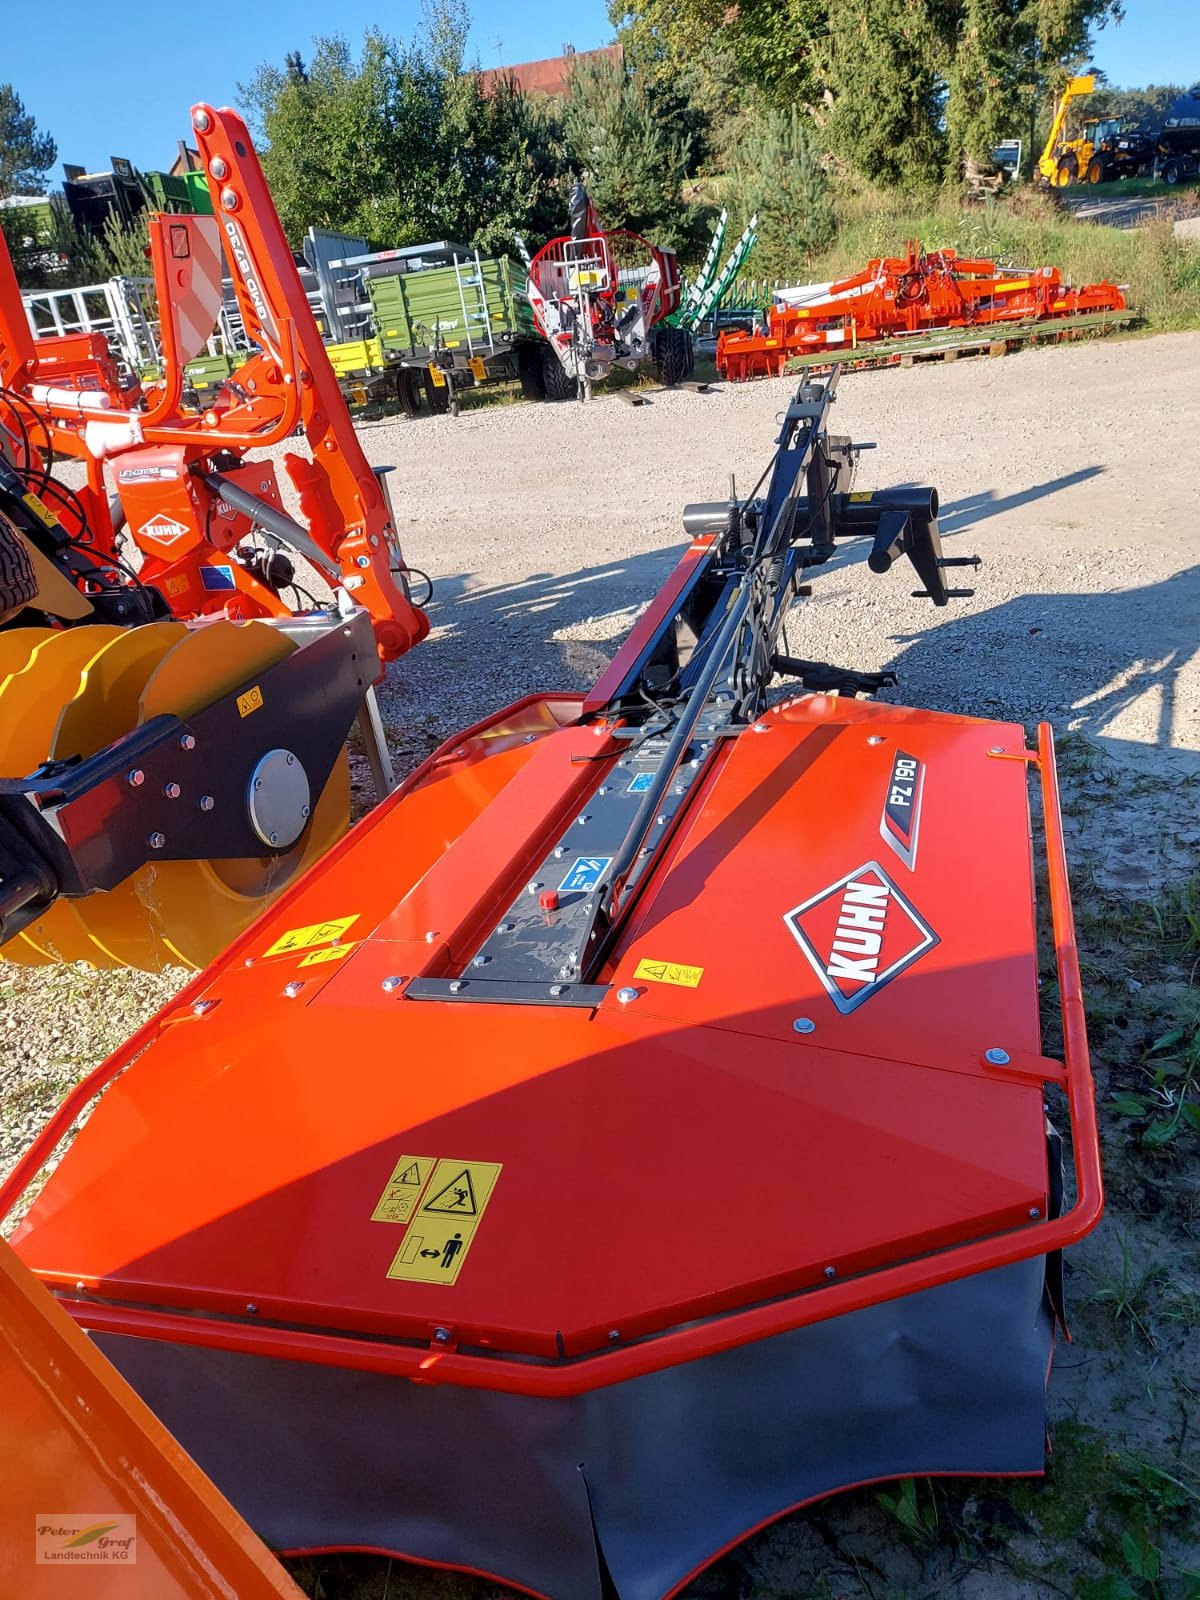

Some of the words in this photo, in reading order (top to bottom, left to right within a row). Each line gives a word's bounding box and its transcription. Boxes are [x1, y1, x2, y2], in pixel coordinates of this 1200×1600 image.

[226, 222, 250, 273] 8730
[247, 278, 267, 320] GMD
[146, 524, 182, 537] KUHN
[894, 759, 917, 781] 190
[889, 785, 913, 806] PZ
[826, 881, 891, 983] KUHN
